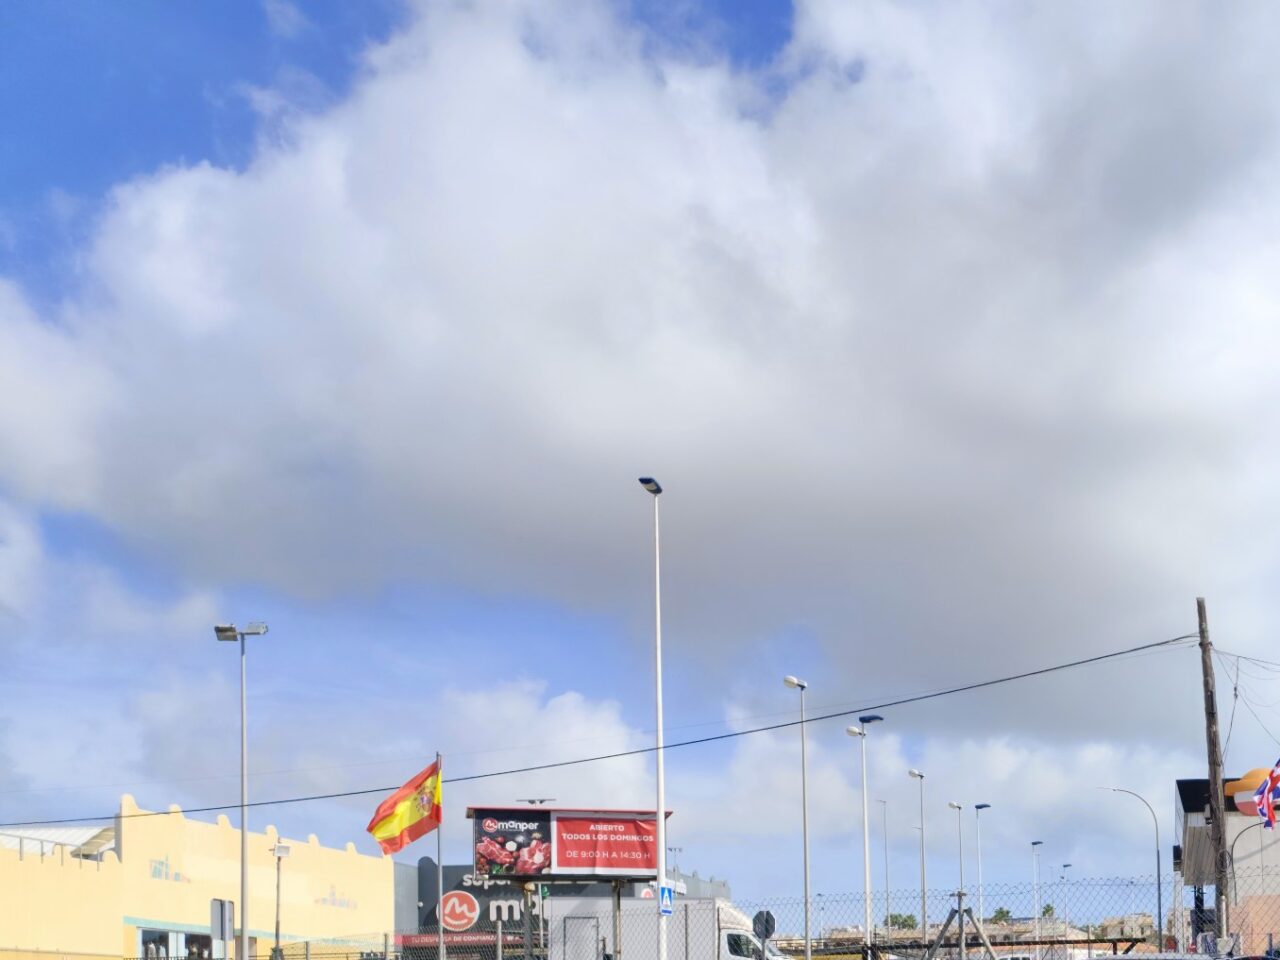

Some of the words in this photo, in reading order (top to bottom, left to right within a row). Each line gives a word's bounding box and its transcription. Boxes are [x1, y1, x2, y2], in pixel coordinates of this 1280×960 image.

[498, 820, 539, 832] manper
[589, 824, 625, 832] ABIERTO
[562, 832, 591, 841] TODOS
[593, 833, 608, 841] LOS
[610, 834, 654, 842] DOMINGOS
[566, 850, 579, 858] DE
[580, 850, 601, 858] 9:00
[620, 851, 642, 859] 14:30
